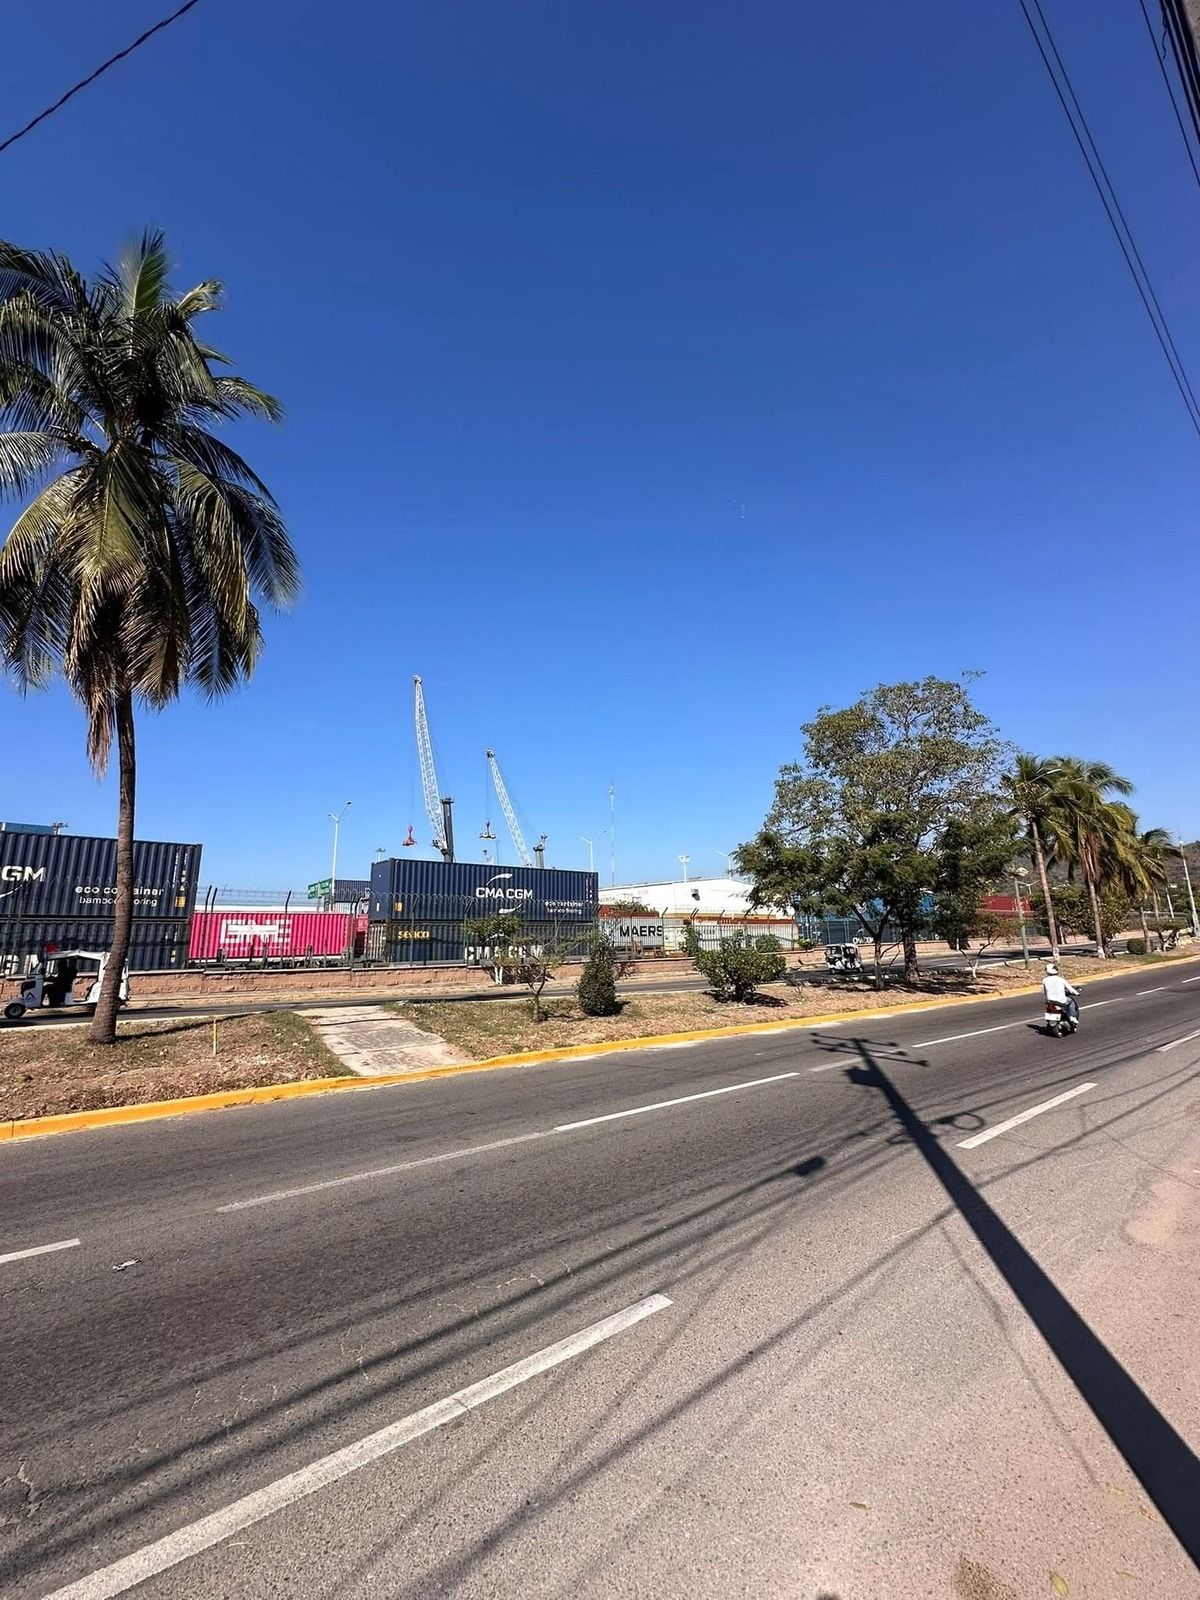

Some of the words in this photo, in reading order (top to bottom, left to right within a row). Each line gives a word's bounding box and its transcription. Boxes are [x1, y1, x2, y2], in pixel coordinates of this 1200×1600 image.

[75, 886, 100, 894] eco
[103, 887, 164, 896] coainer
[475, 887, 504, 899] CMA
[505, 888, 533, 900] CGM
